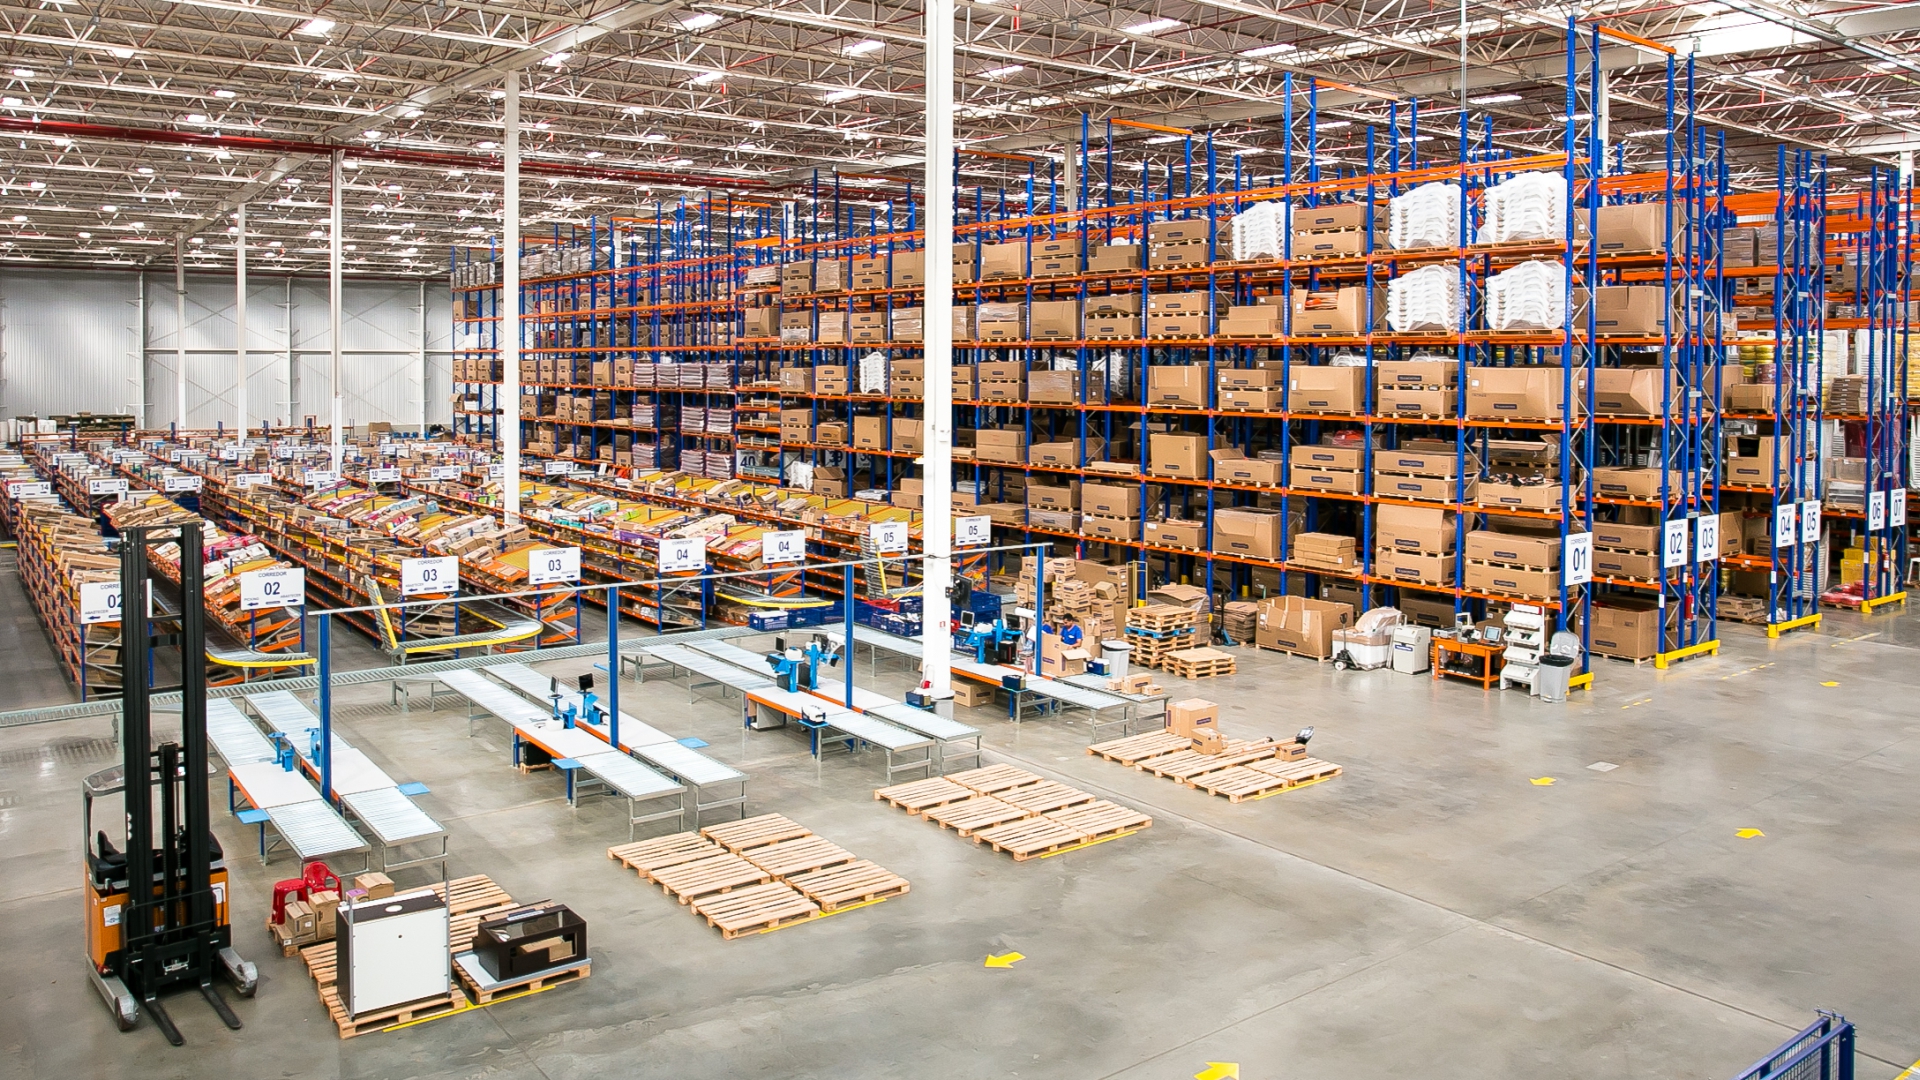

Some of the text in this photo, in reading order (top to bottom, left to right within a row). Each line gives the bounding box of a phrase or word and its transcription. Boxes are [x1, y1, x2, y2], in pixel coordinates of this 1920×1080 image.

[740, 456, 756, 467] 40
[1872, 502, 1881, 520] 06
[1893, 499, 1902, 516] 07
[1780, 516, 1791, 536] 04
[1806, 512, 1816, 531] 05
[968, 525, 978, 535] 05
[884, 532, 894, 543] 05
[1670, 532, 1682, 554] 02
[1702, 527, 1714, 549] 03
[778, 541, 789, 552] 04
[676, 549, 688, 560] 04
[1573, 546, 1586, 571] 01
[548, 559, 562, 572] 03
[423, 569, 438, 582] 03
[264, 581, 281, 596] 02
[107, 594, 121, 608] 02
